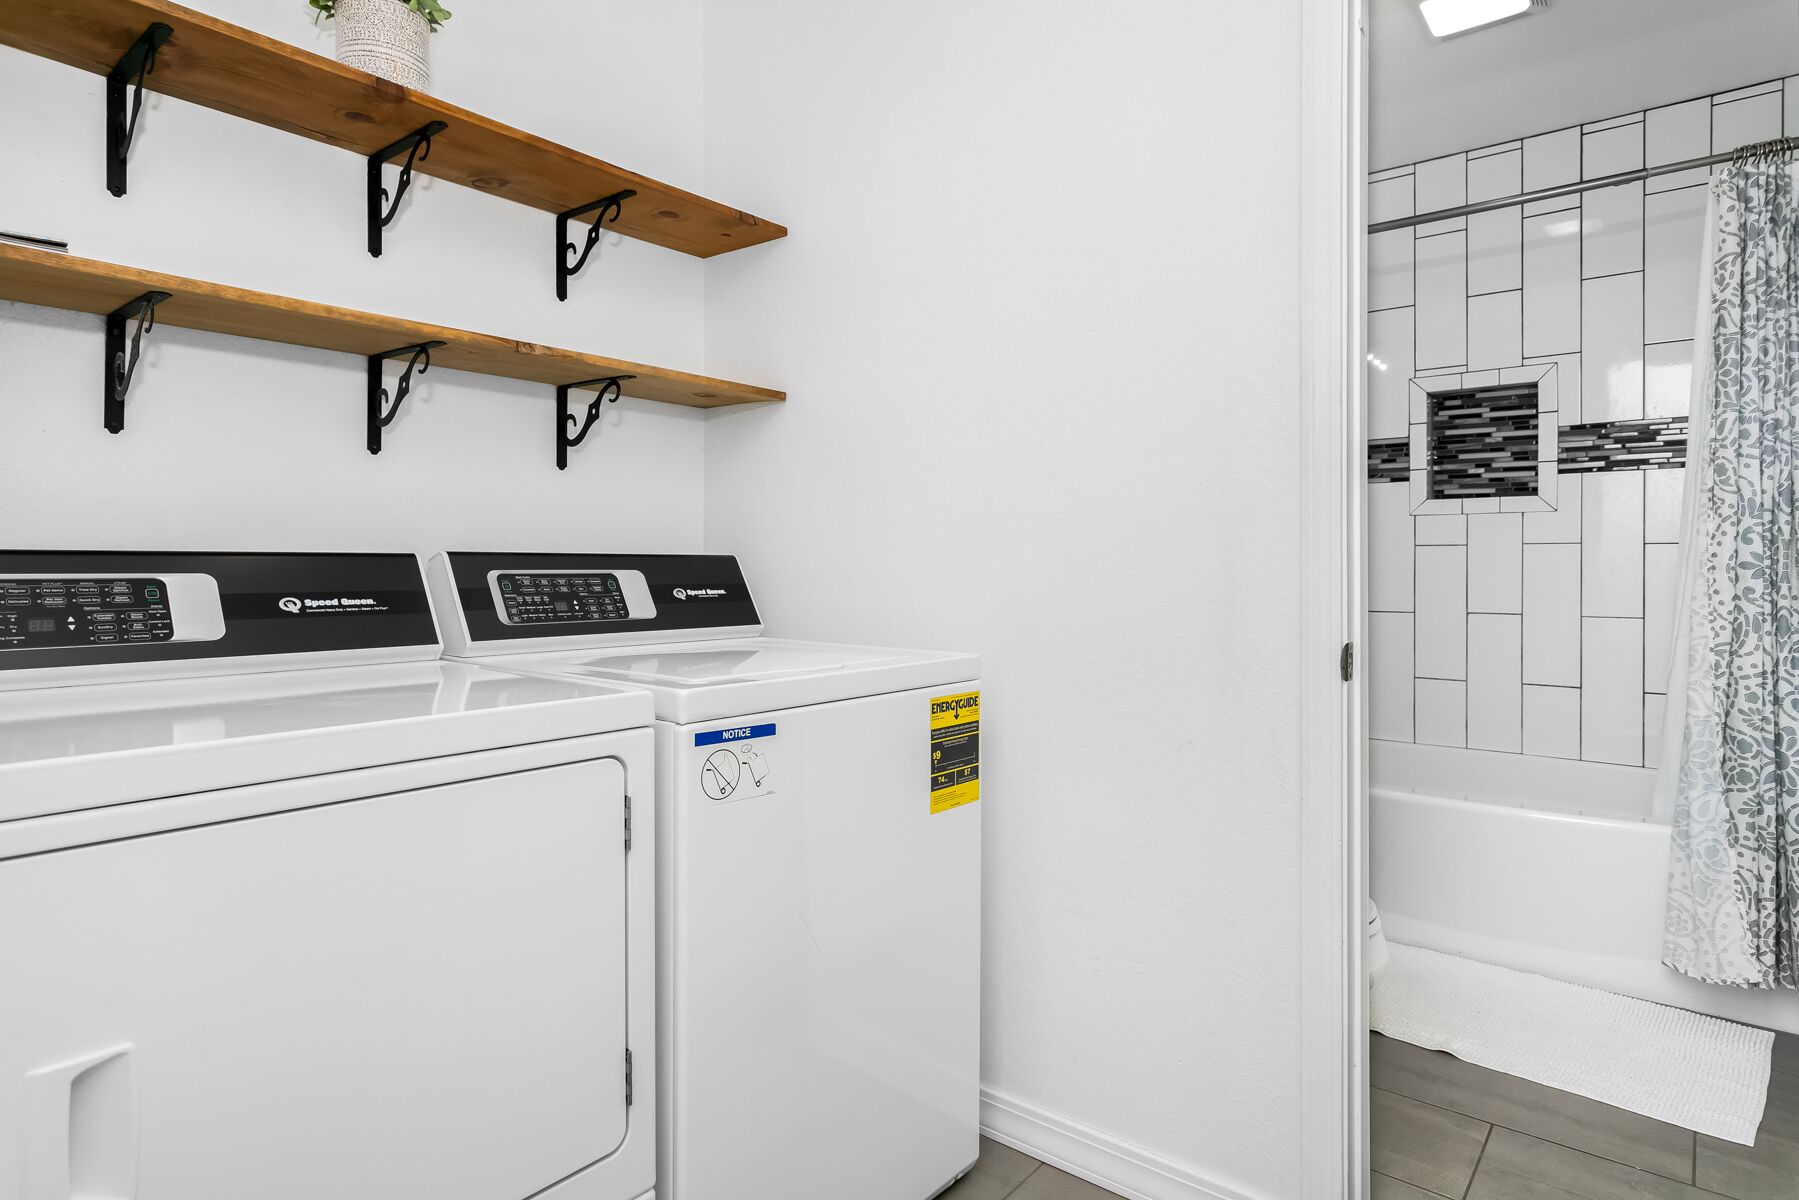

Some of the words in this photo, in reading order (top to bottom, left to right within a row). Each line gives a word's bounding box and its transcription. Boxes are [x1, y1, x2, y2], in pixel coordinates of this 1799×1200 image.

[304, 598, 339, 608] Speed
[722, 728, 751, 739] NOTICE
[932, 750, 941, 760] $9
